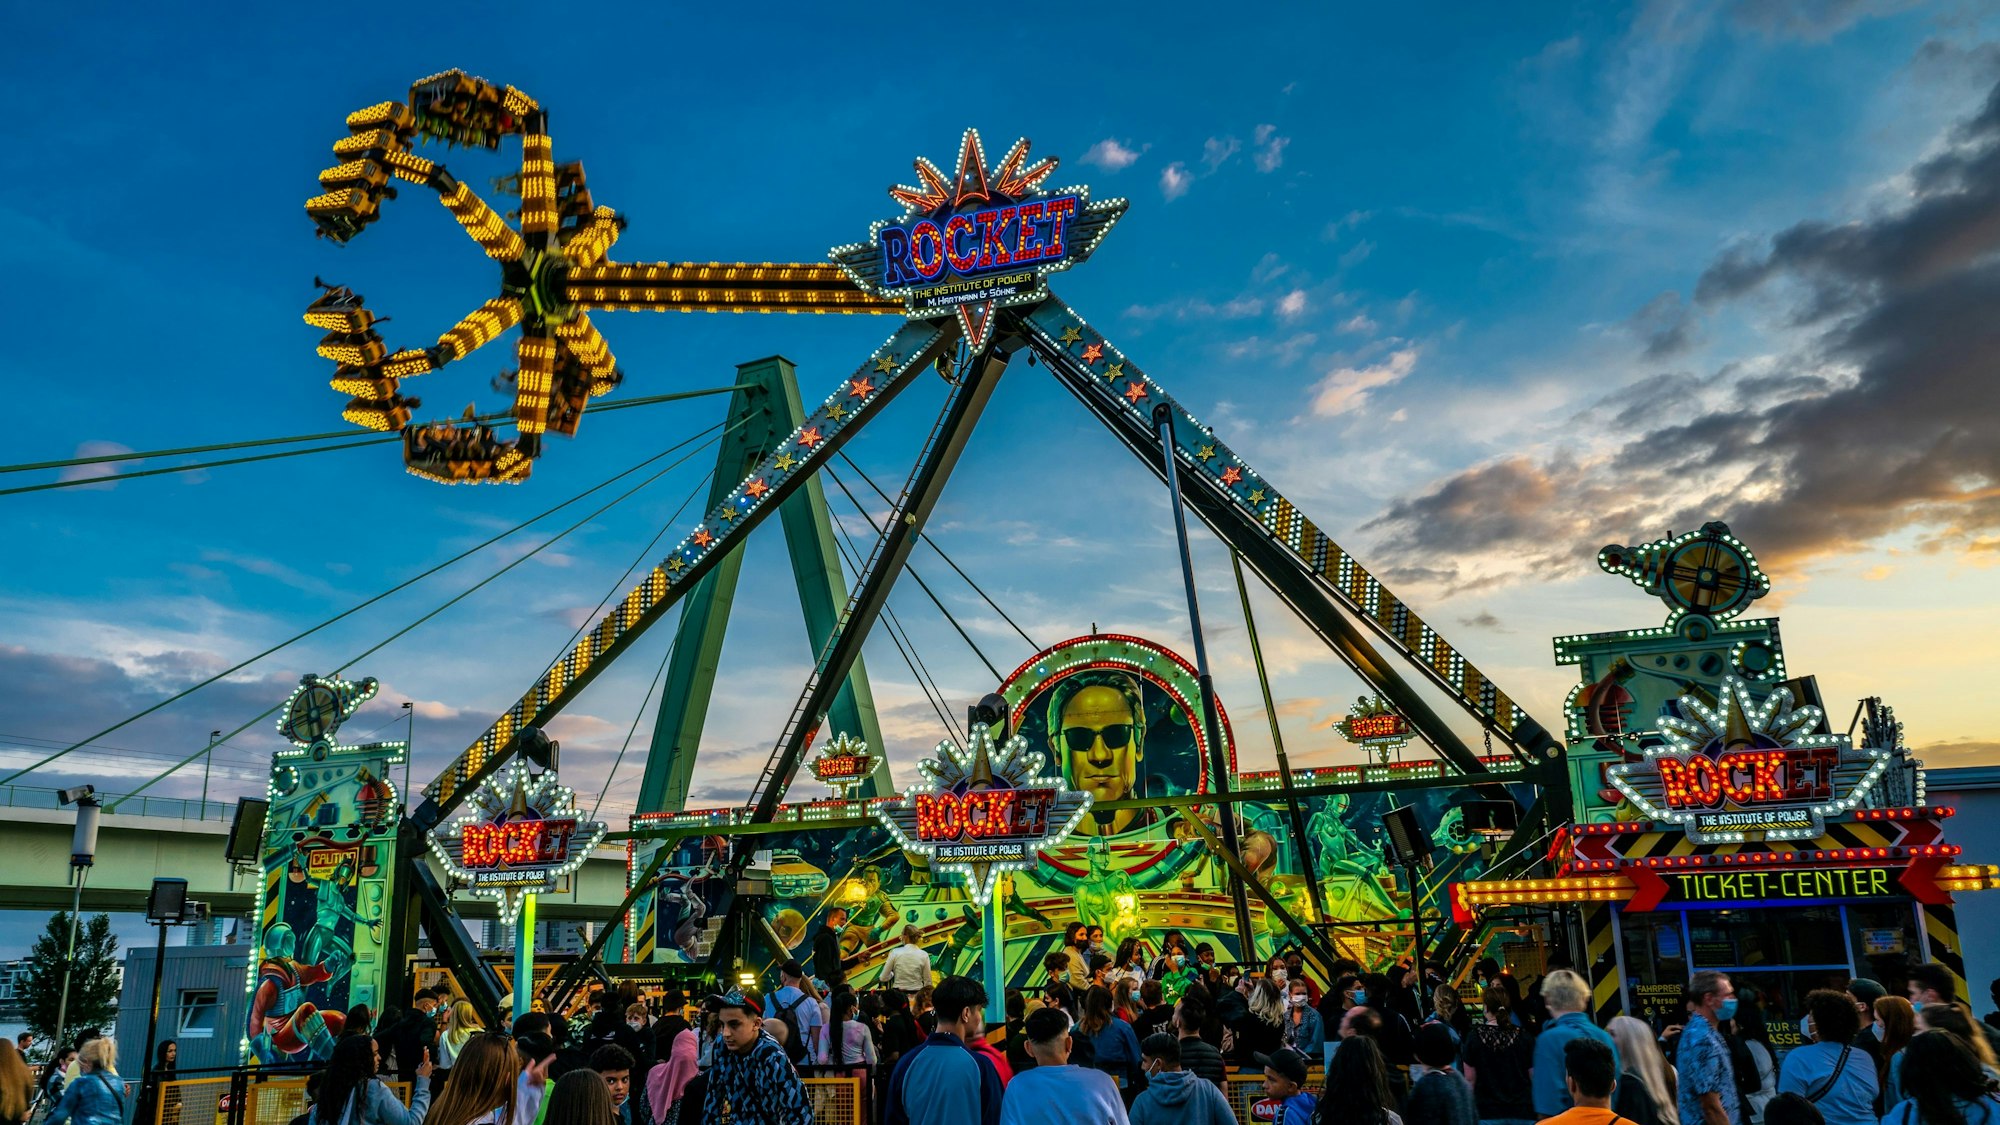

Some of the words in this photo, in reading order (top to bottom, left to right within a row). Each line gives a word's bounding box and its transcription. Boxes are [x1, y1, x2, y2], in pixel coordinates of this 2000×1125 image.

[880, 196, 1077, 285] ROCKET
[914, 288, 933, 299] THE
[934, 281, 982, 296] INSTITUTE
[983, 279, 995, 287] OF
[997, 273, 1032, 286] POWER
[927, 298, 937, 307] M.
[979, 290, 988, 298] &
[819, 756, 870, 776] ROCKET
[1656, 746, 1840, 807] ROCKET
[915, 788, 1057, 840] ROCKET
[1700, 815, 1717, 826] THE
[1719, 812, 1763, 825] INSTITUTE
[1764, 812, 1776, 822] OF
[1777, 810, 1808, 822] POWER
[463, 819, 577, 865] ROCKET
[939, 847, 952, 856] THE
[953, 846, 987, 856] INSTITUTE
[989, 845, 998, 855] OF
[999, 844, 1022, 854] POWER
[478, 873, 489, 882] THE
[489, 871, 517, 881] INSTITUTE
[517, 871, 525, 880] OF
[525, 870, 545, 880] POWER
[1677, 869, 1889, 899] TICKET-CENTER
[1636, 984, 1681, 993] FAHRPREIS
[1651, 996, 1678, 1005] Person
[1765, 1022, 1790, 1032] ZUR
[1768, 1032, 1803, 1045] ASSE
